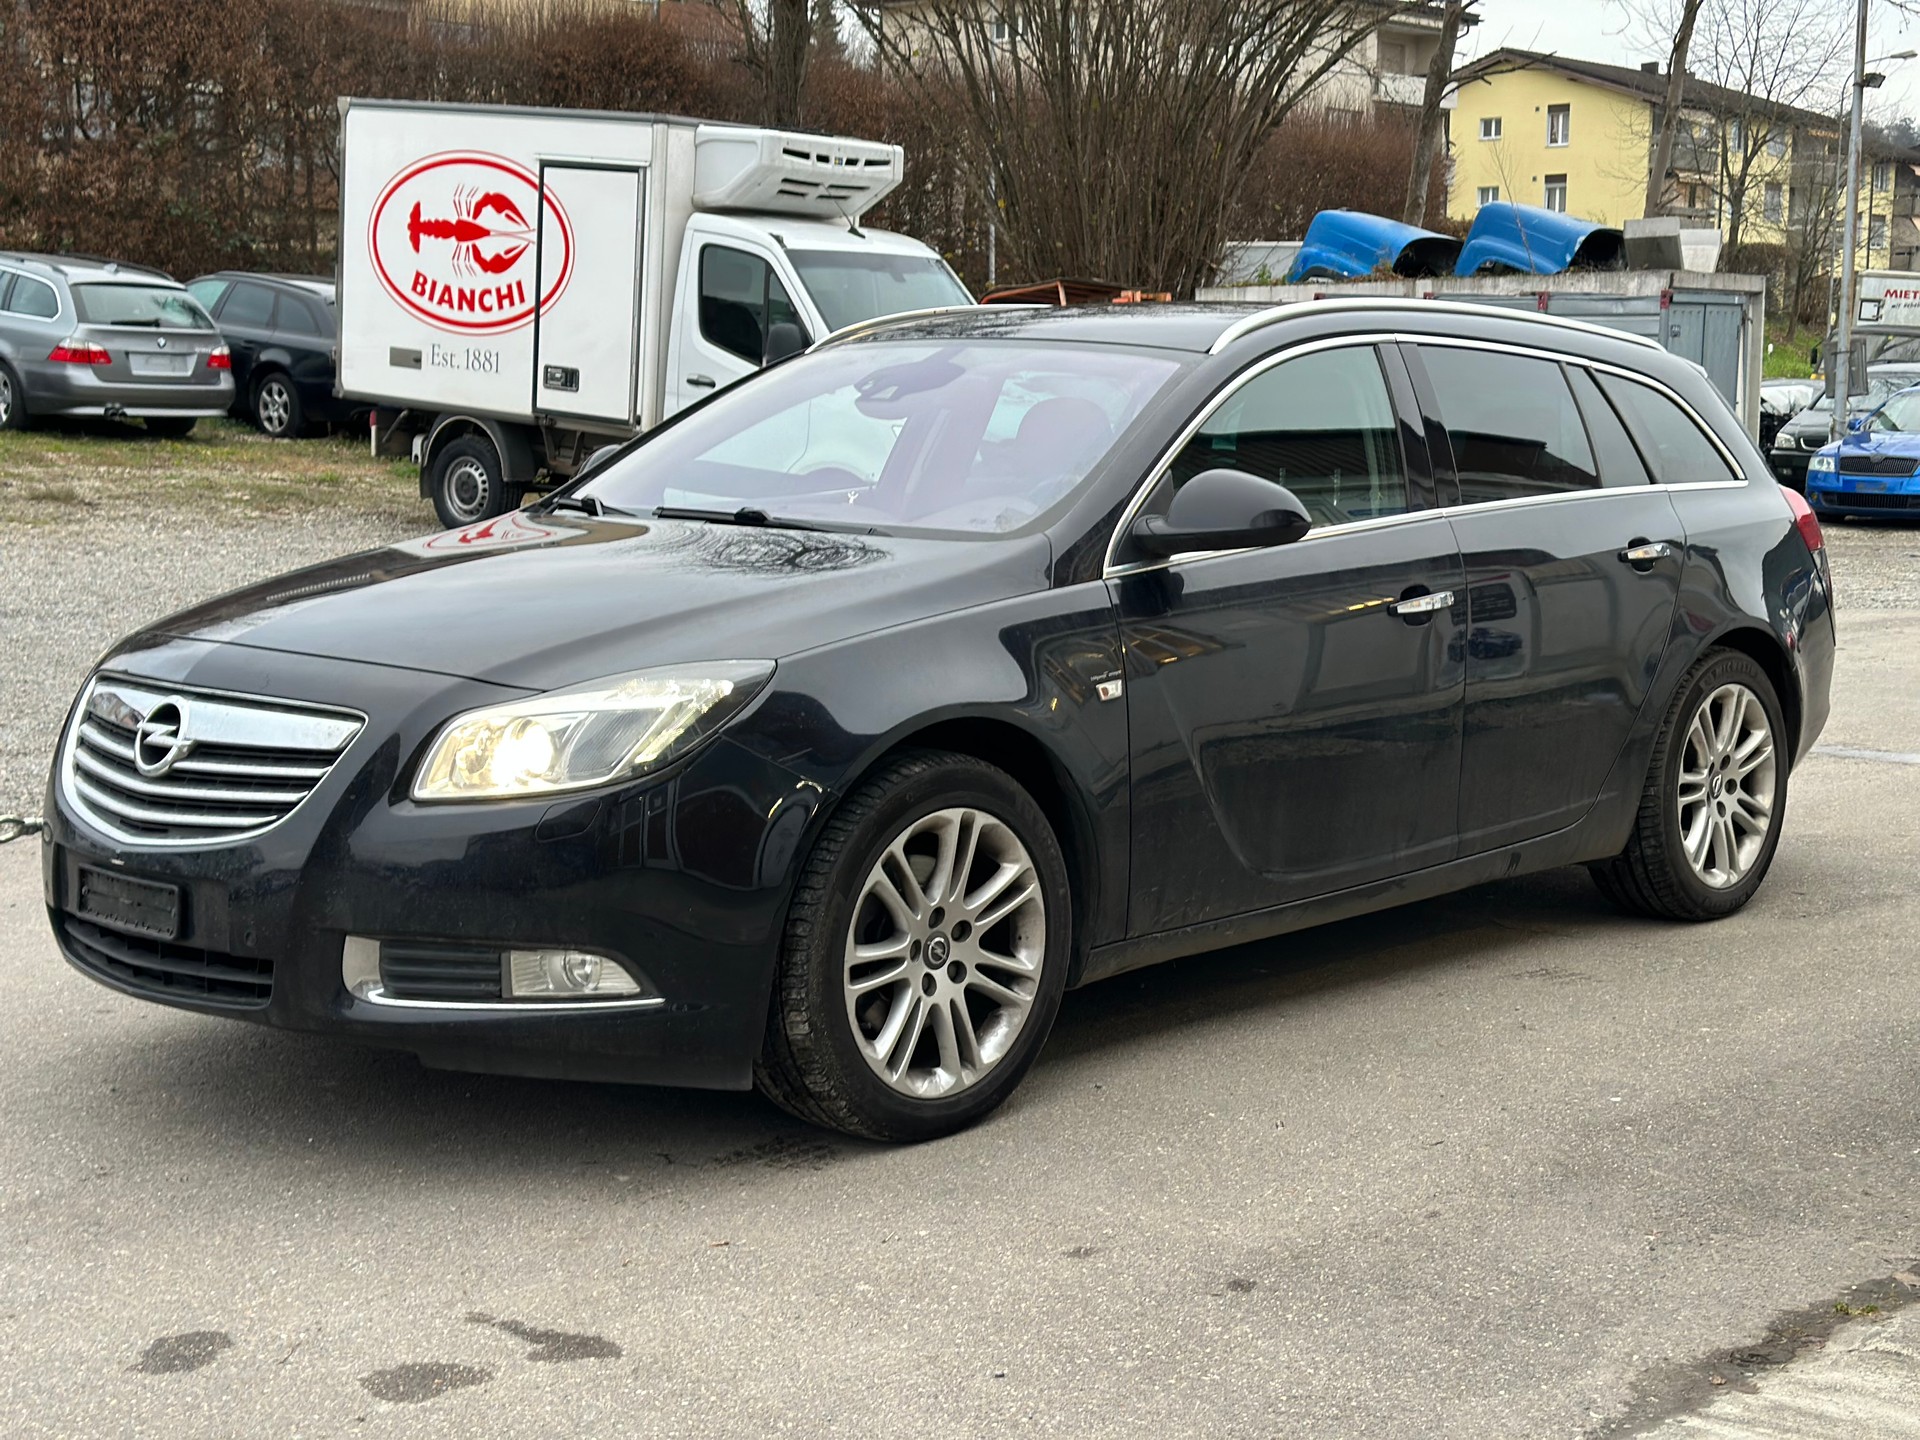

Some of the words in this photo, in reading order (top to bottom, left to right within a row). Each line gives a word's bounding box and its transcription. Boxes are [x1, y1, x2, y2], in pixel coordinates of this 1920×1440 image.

[411, 270, 525, 312] BIANCHI
[431, 343, 460, 369] Est.
[465, 347, 500, 373] 1881
